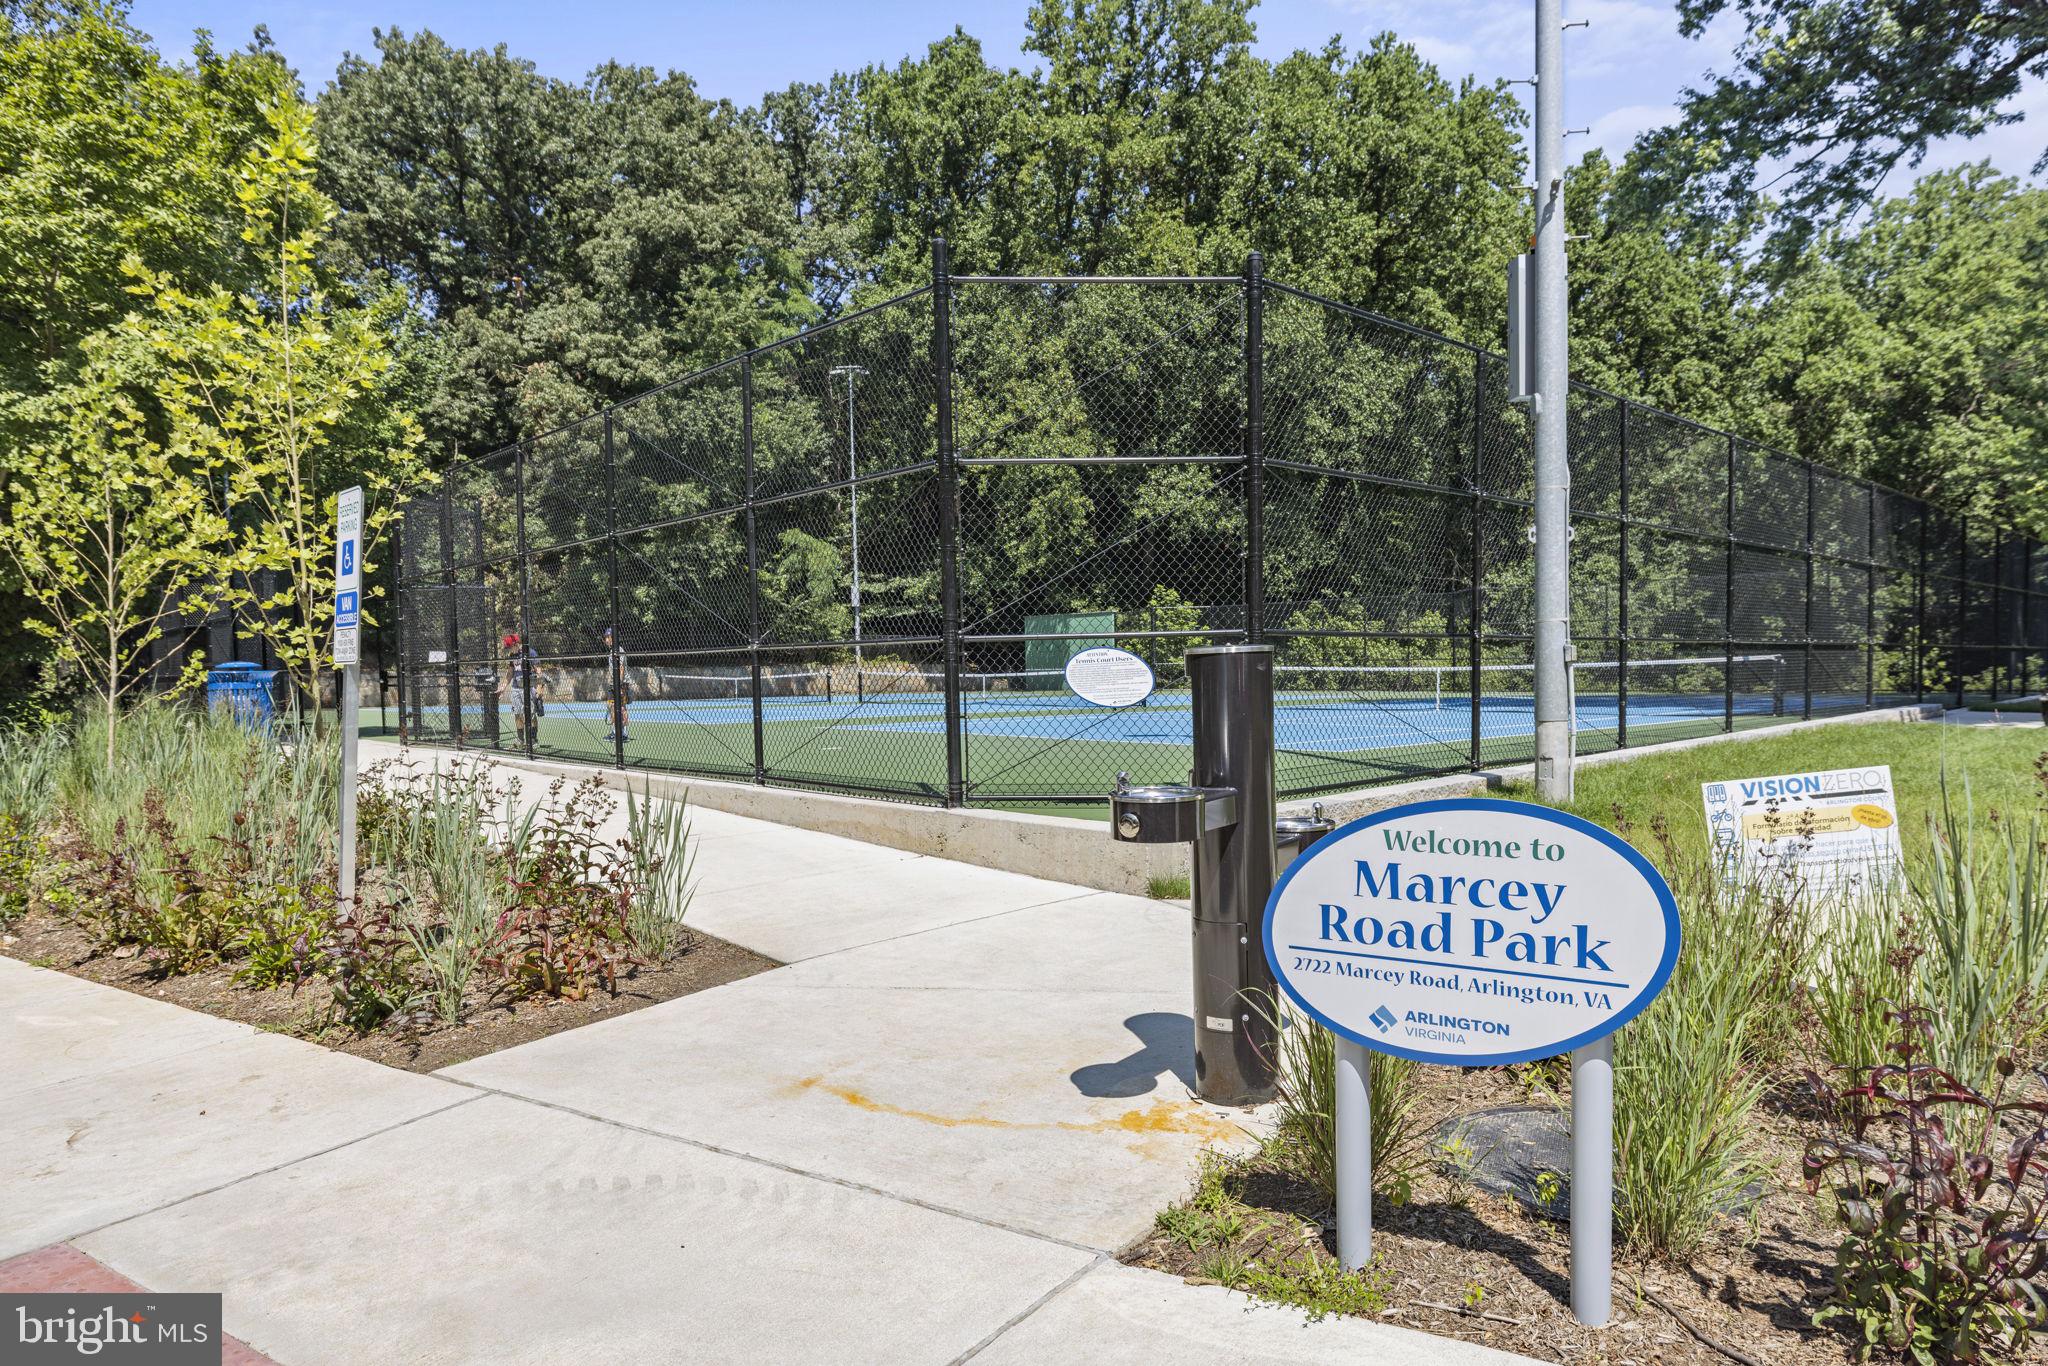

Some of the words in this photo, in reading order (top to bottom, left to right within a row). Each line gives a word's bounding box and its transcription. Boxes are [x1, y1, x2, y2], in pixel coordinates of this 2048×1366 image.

[339, 501, 360, 518] RESERVED
[340, 517, 358, 533] PARKING
[341, 596, 353, 611] VAN
[336, 613, 357, 624] ACCESSIBLE
[1383, 829, 1521, 859] Welcome
[1530, 837, 1565, 862] to
[1837, 838, 1853, 846] para
[1353, 859, 1567, 924] Marcey
[1318, 903, 1453, 954] Road
[1471, 918, 1614, 972] Park
[1294, 956, 1332, 974] 2722
[1336, 961, 1405, 986] Marcey
[1410, 970, 1464, 993] Road,
[1467, 977, 1579, 1008] Arlington,
[1583, 992, 1613, 1010] VA
[1404, 1010, 1510, 1036] ARLINGTON
[1404, 1027, 1466, 1044] VIRGINIA
